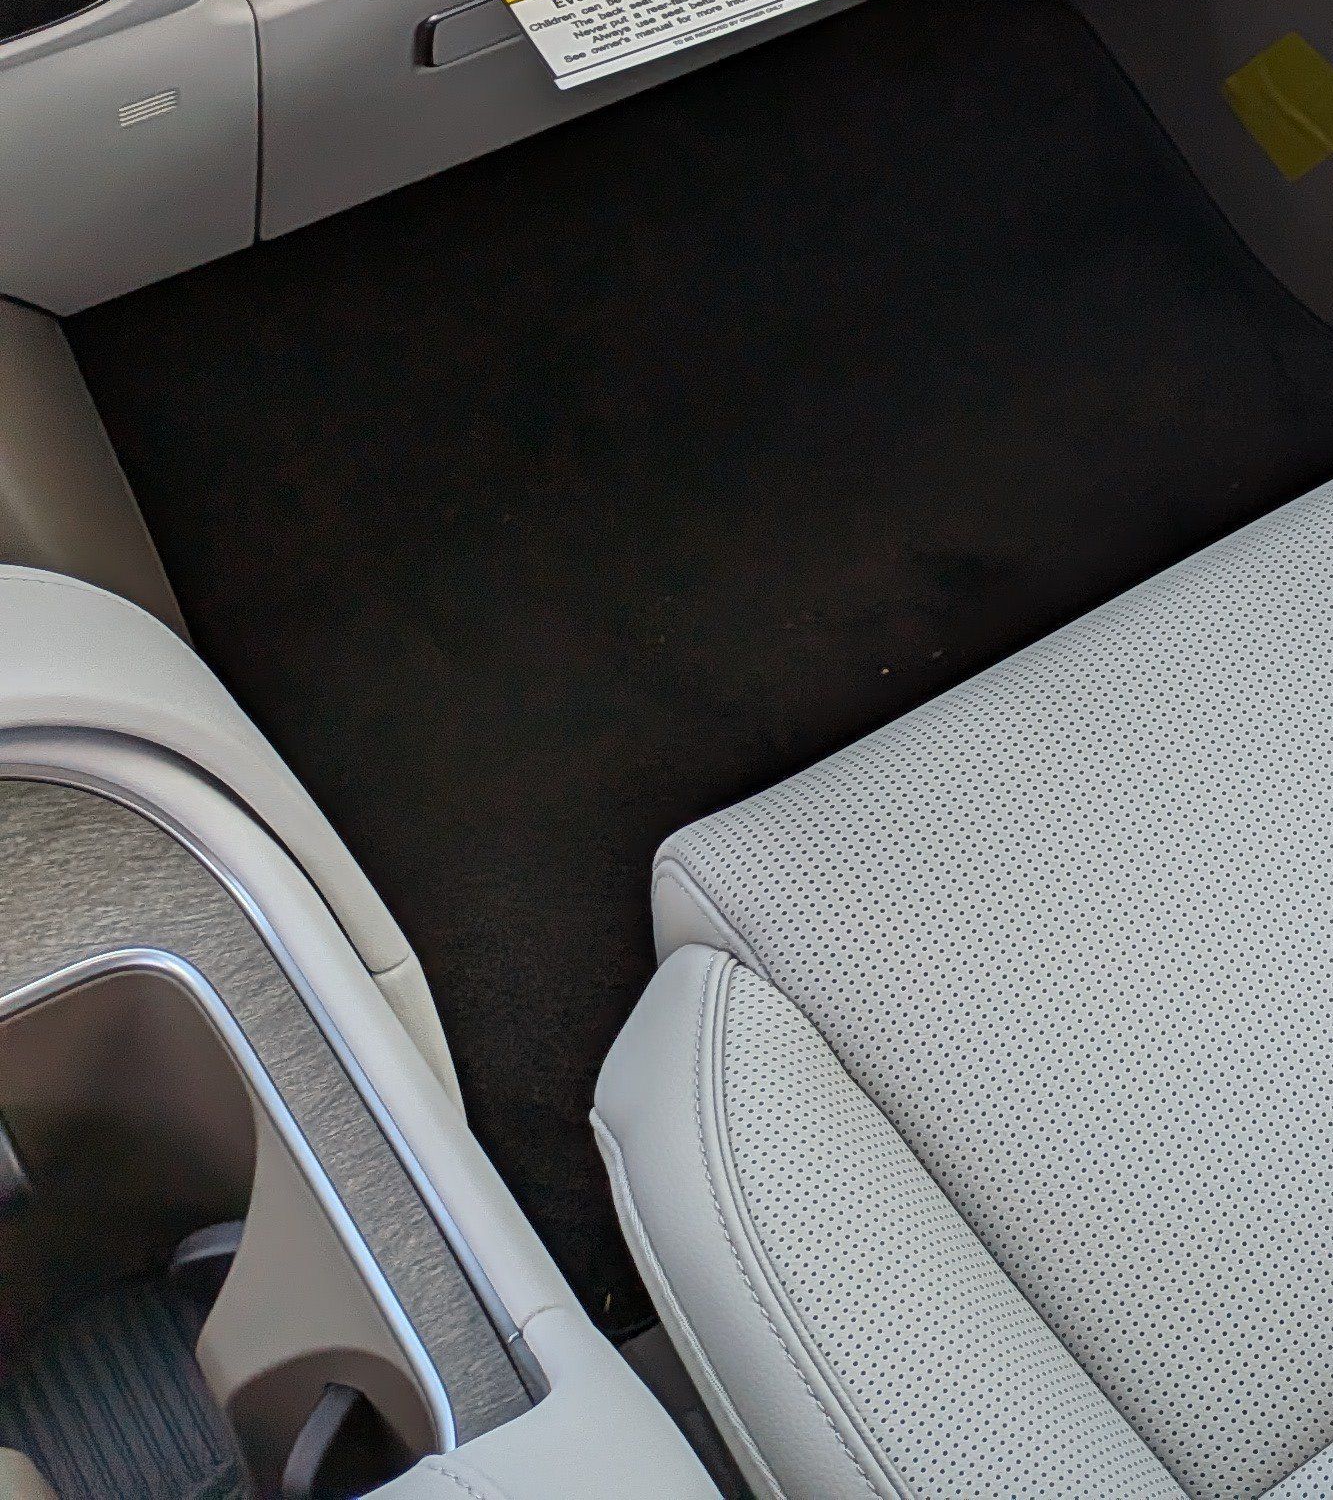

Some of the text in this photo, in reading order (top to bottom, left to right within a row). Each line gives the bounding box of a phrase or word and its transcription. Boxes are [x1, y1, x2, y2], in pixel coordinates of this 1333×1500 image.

[529, 12, 576, 32] Children
[581, 2, 601, 15] can
[571, 18, 594, 28] The
[598, 6, 626, 21] back
[572, 23, 608, 39] Never
[610, 16, 629, 29] put
[592, 26, 632, 44] Always
[635, 18, 657, 28] use
[661, 7, 685, 20] seat
[564, 52, 586, 63] See
[591, 36, 632, 54] owner's
[635, 21, 674, 39] manual
[676, 15, 692, 24] for
[696, 5, 722, 17] more
